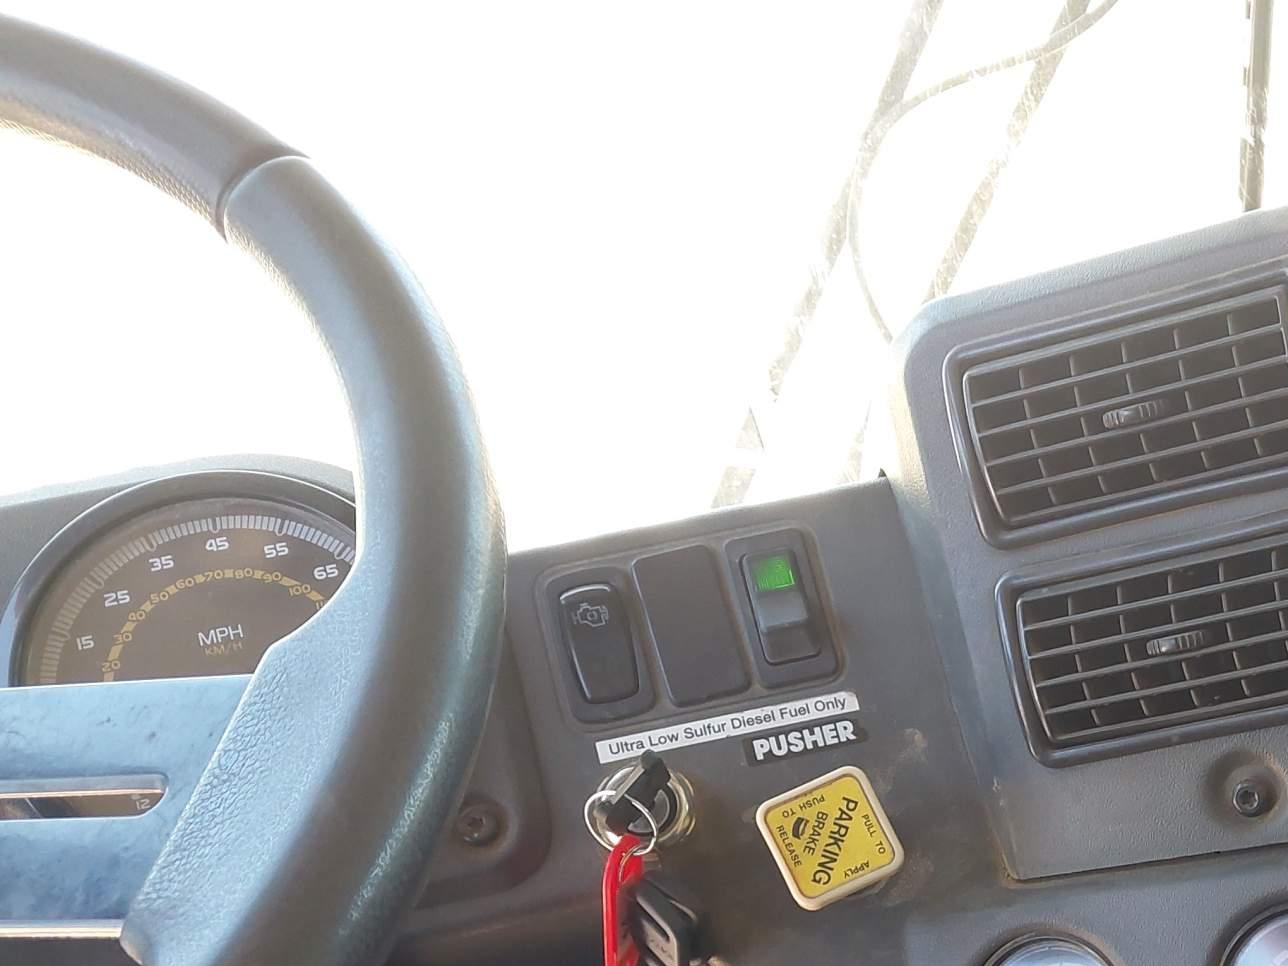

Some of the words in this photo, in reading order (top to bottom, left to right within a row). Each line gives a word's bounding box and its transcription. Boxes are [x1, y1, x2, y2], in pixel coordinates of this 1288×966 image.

[205, 536, 229, 552] 45
[263, 543, 289, 558] 55
[149, 555, 174, 572] 35
[204, 569, 224, 582] 70
[234, 567, 253, 579] 80
[263, 572, 282, 583] 90
[313, 564, 339, 580] 65
[175, 577, 194, 589] 60
[289, 584, 311, 597] 100
[104, 590, 130, 607] 25
[150, 591, 169, 604] 50
[128, 610, 146, 622] 40
[76, 635, 95, 651] 15
[114, 632, 132, 644] 30
[198, 624, 244, 647] MPH
[205, 642, 242, 656] KM/H
[101, 660, 121, 672] 20
[608, 740, 645, 755] Ultra
[650, 733, 679, 747] Low
[683, 722, 726, 740] Sulfur
[731, 710, 776, 730] Diesel
[779, 703, 810, 720] Fuel
[814, 697, 847, 713] Only
[752, 719, 857, 761] PUSHER
[799, 794, 825, 812] PUSH
[782, 808, 796, 818] TO
[803, 811, 829, 856] BRAKE
[811, 796, 859, 886] PARKING
[861, 814, 877, 838] PULL
[875, 840, 886, 855] TO
[776, 824, 802, 868] RELEASE
[844, 860, 870, 879] APPLY
